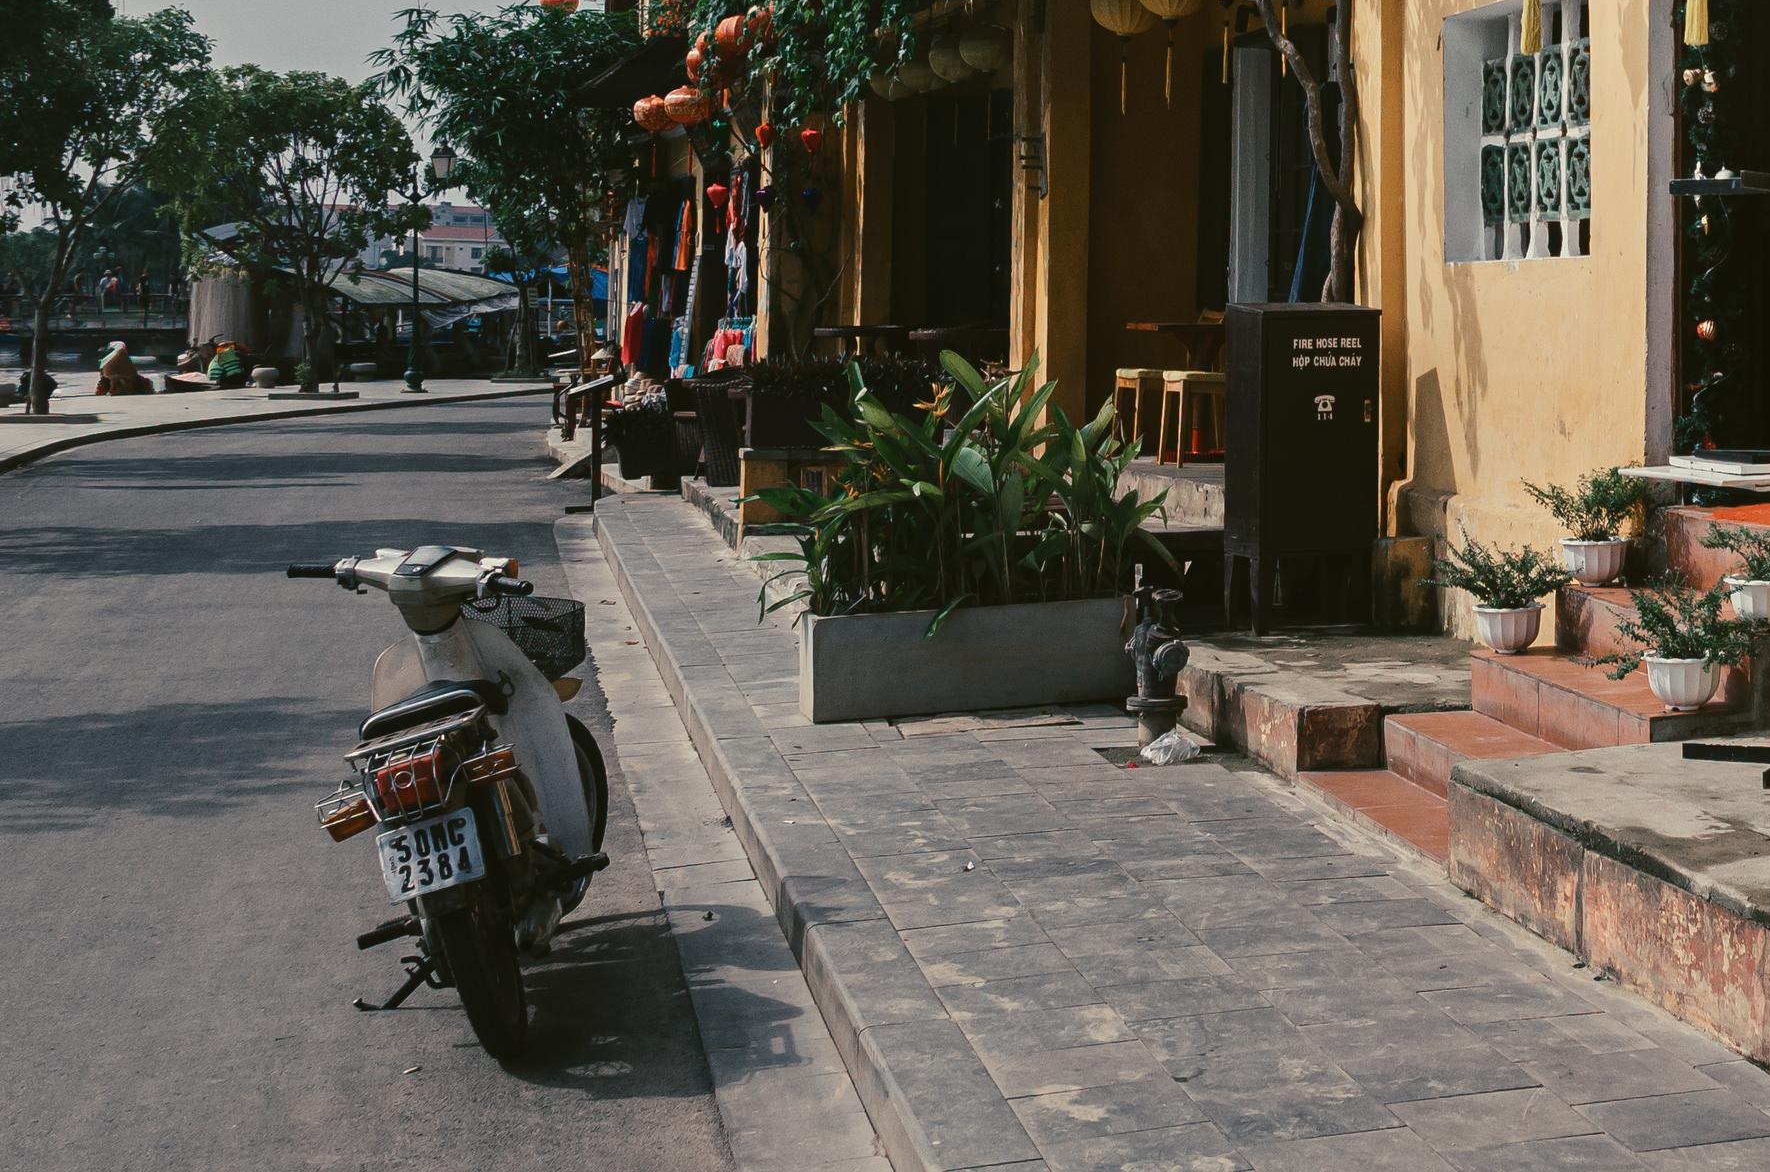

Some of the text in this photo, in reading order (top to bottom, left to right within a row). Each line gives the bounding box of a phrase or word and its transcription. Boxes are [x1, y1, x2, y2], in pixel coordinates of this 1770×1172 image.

[1293, 338, 1362, 349] FIRE HOSE REEL
[1292, 354, 1310, 370] HỘP
[1313, 351, 1337, 367] CHỨA
[398, 847, 472, 893] 2384
